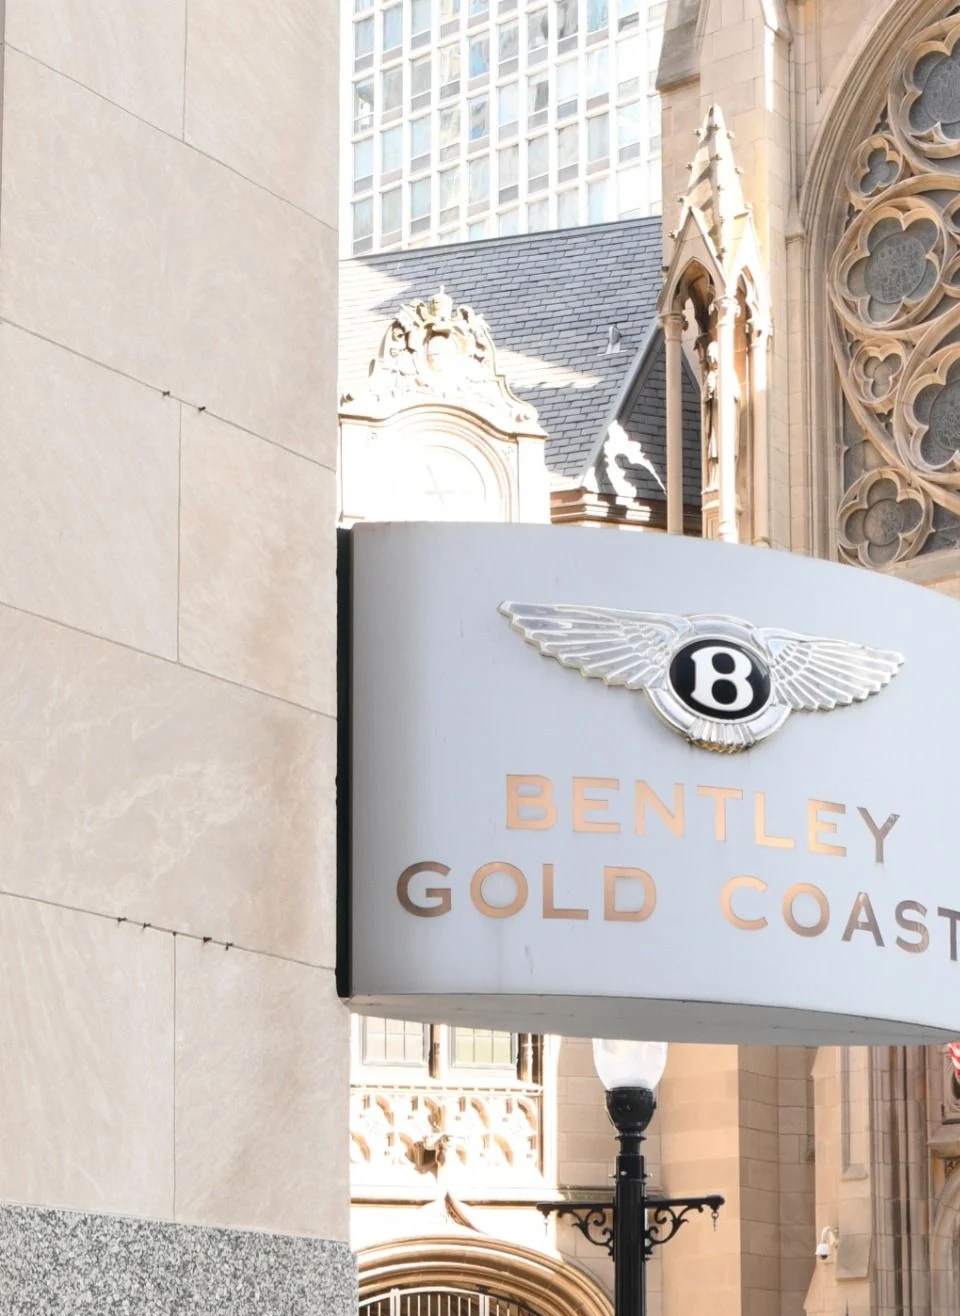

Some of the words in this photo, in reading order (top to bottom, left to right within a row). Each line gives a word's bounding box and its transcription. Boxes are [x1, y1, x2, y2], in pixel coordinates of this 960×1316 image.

[690, 645, 755, 712] B
[505, 773, 900, 864] BENTLEY
[396, 860, 657, 922] GOLD
